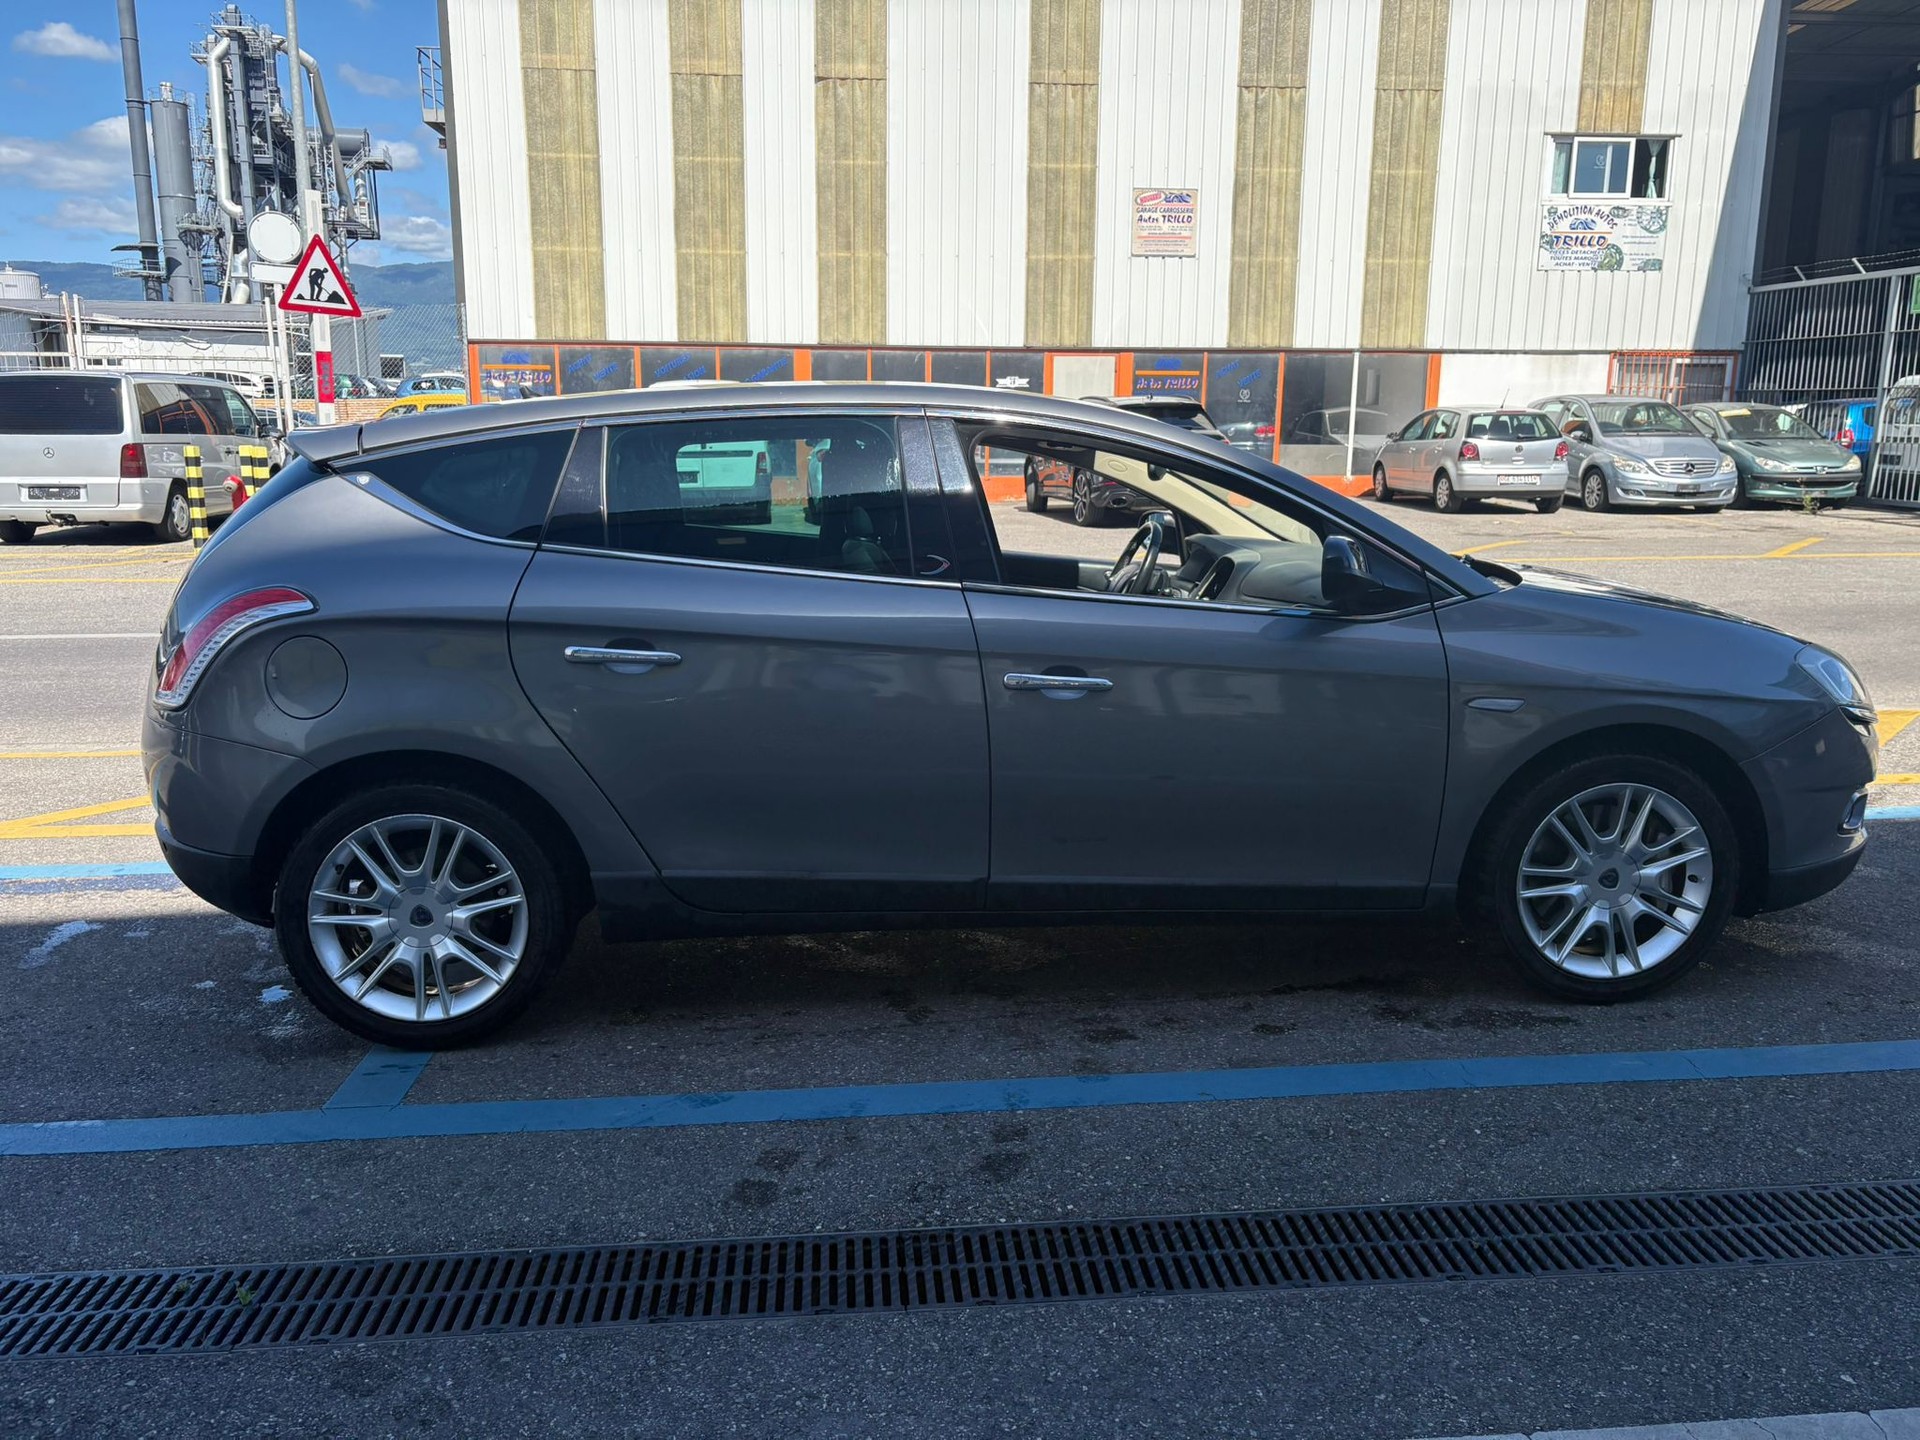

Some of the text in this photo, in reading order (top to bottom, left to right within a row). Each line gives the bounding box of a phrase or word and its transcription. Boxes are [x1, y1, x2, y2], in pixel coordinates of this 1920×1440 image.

[1159, 206, 1194, 214] CARROSSERIE
[1161, 214, 1193, 224] TRILLO
[1594, 208, 1618, 230] AUTOS
[1553, 235, 1608, 248] TRILLO
